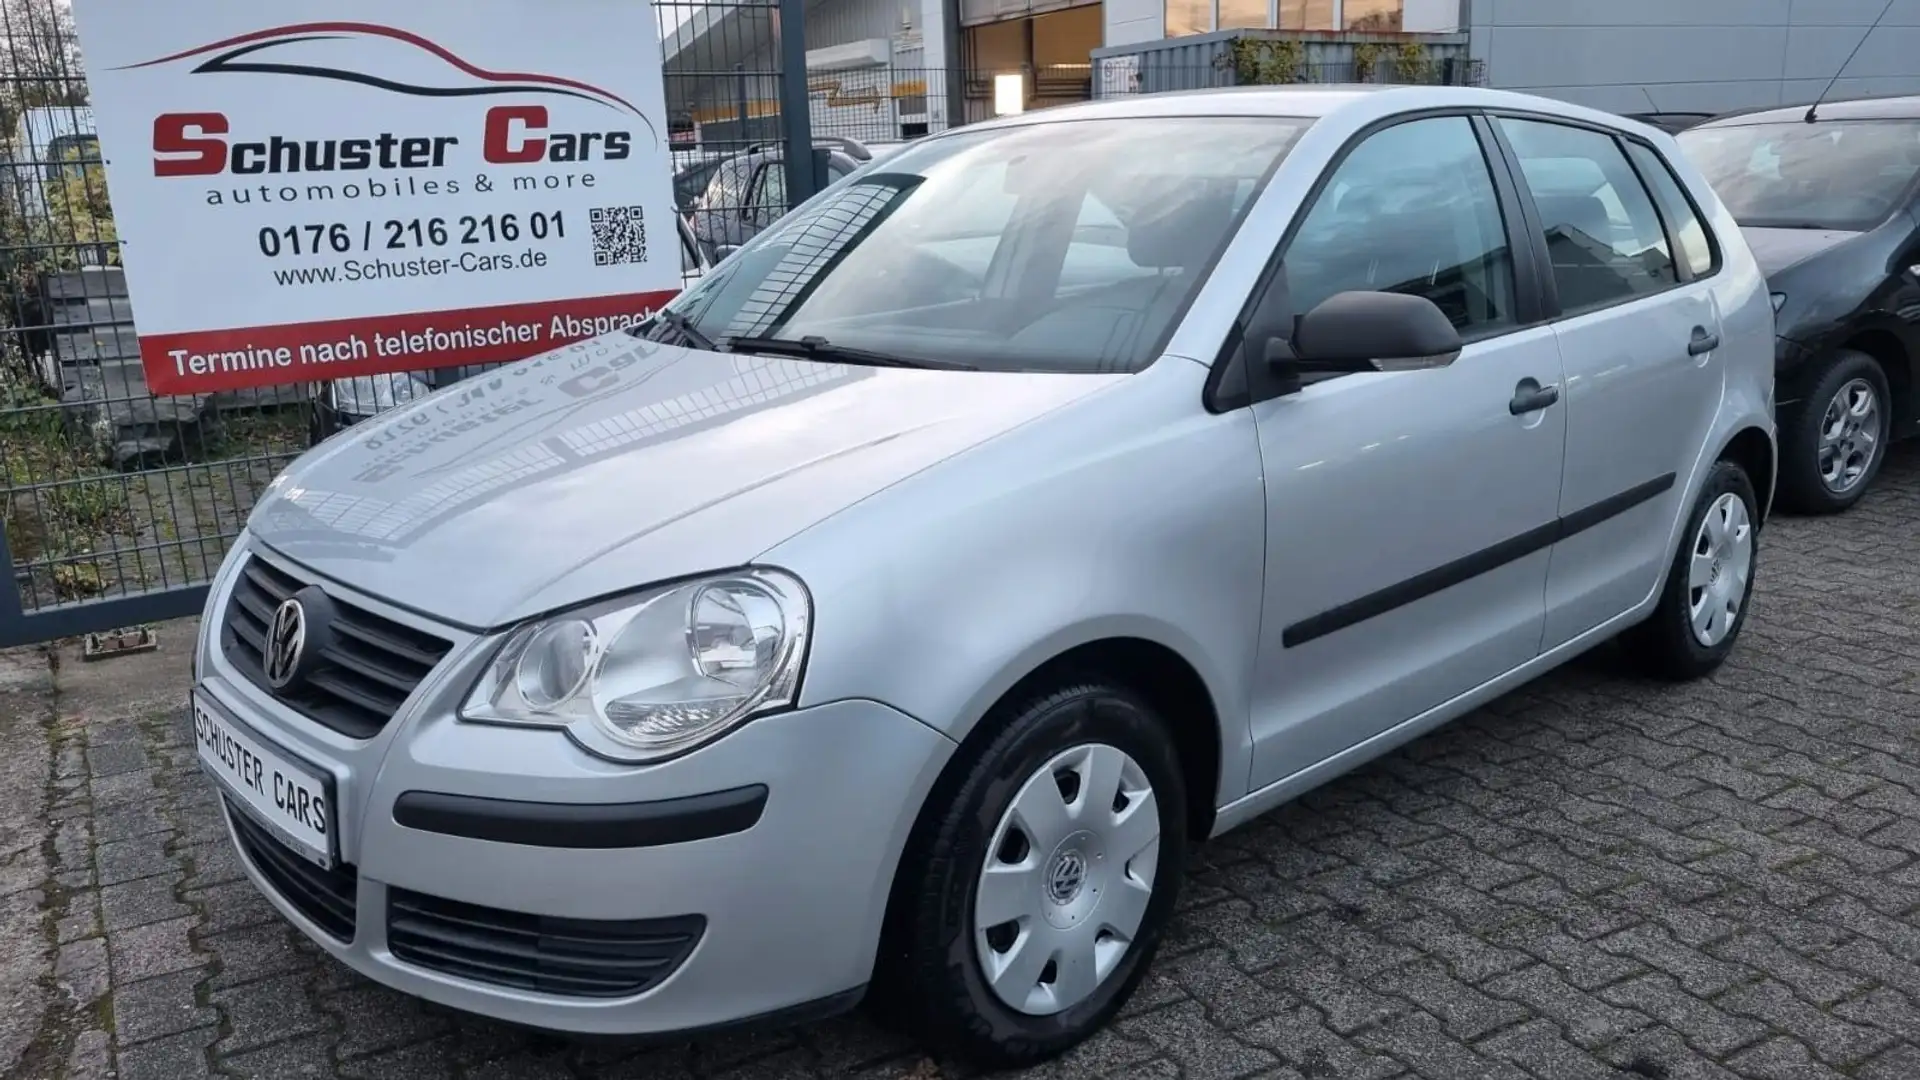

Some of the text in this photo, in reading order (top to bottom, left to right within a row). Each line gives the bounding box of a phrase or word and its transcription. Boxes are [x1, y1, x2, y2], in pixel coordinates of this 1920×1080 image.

[153, 105, 631, 177] Schuster Cars
[206, 173, 596, 205] automobiles & more
[258, 210, 565, 257] 0176 / 216 216 01
[273, 248, 548, 286] www.Schuster-Cars.de
[168, 344, 292, 377] Termine
[300, 334, 368, 365] nach
[374, 321, 542, 357] telefonischer
[196, 707, 327, 834] SCHUSTER CARS
